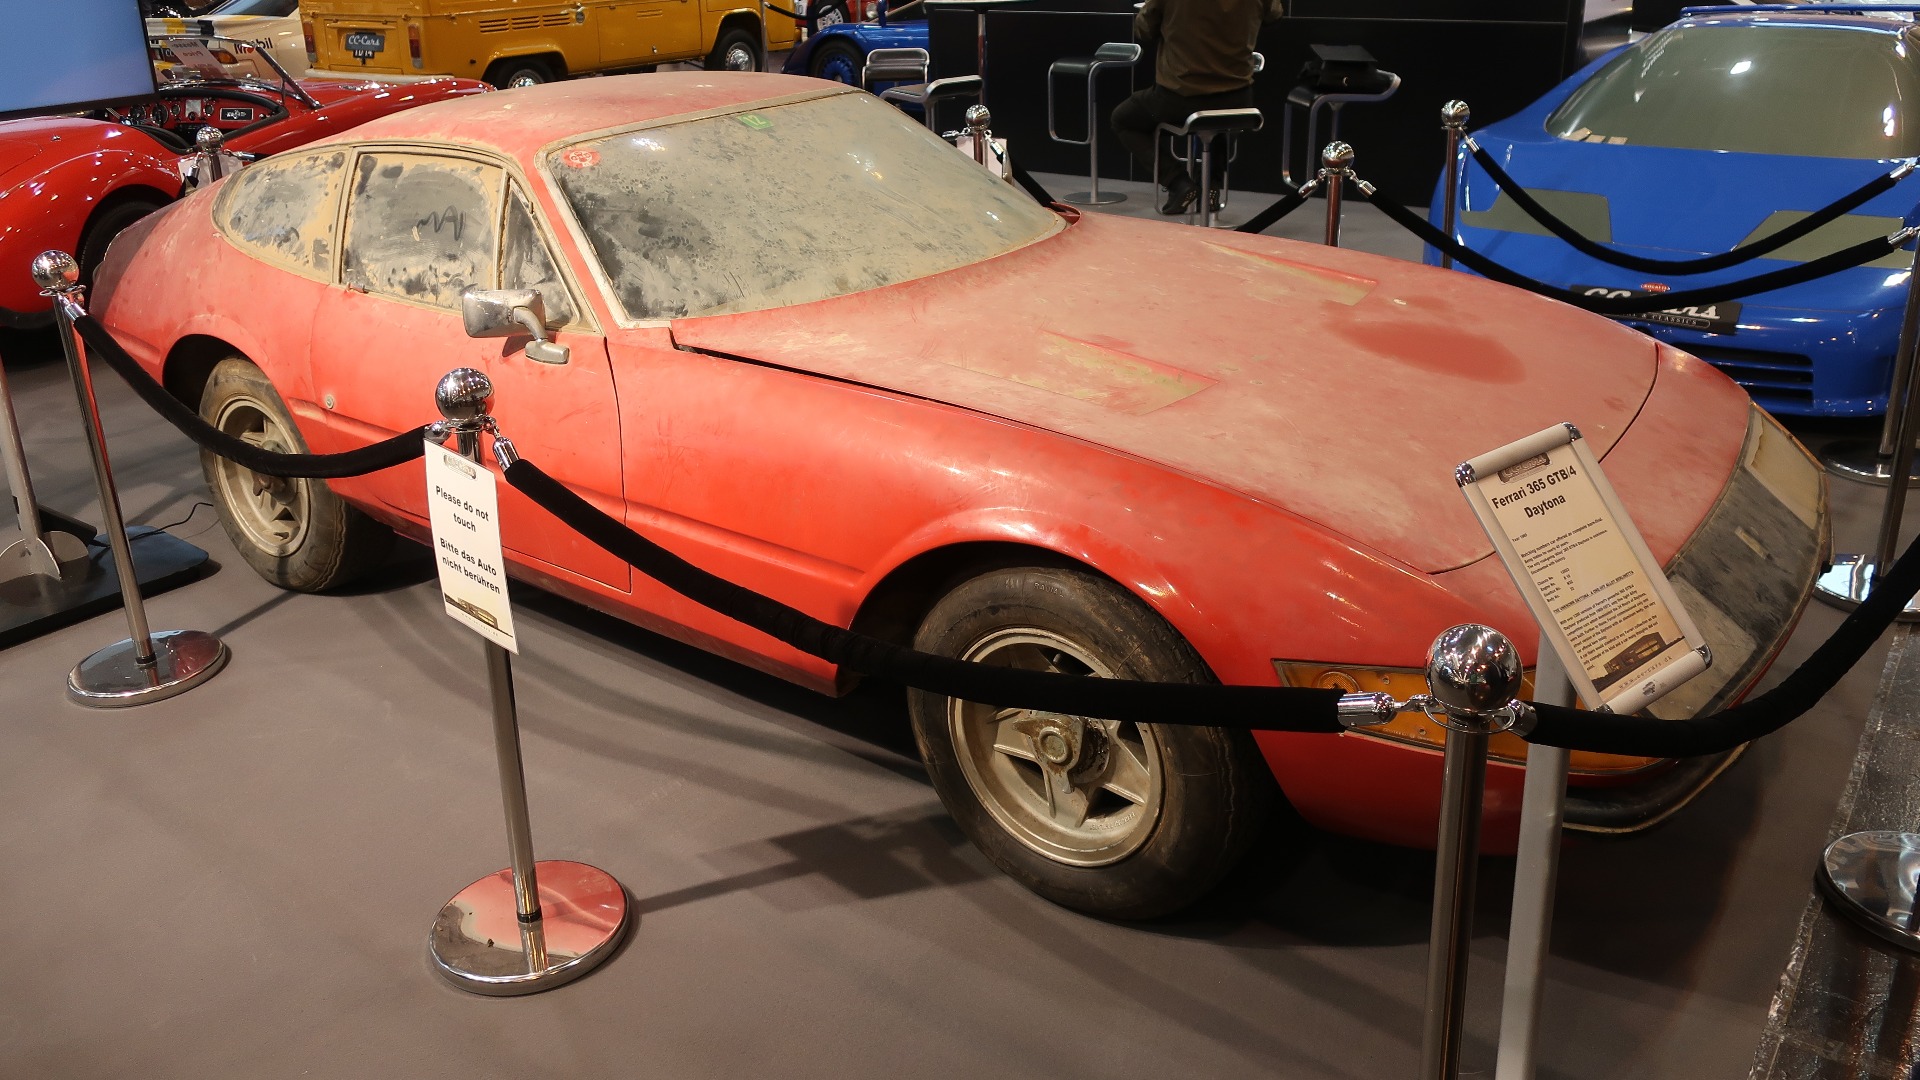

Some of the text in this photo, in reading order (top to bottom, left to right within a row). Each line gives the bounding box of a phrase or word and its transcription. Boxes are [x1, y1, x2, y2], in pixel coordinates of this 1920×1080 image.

[348, 34, 380, 46] CC-Cars
[1652, 314, 1697, 326] CLASSICS
[1491, 487, 1526, 508] Ferrari
[1526, 478, 1546, 494] 365
[1546, 465, 1576, 485] GTB/4
[436, 484, 490, 523] Please do not
[1524, 495, 1566, 518] Daytona
[453, 512, 477, 533] touch
[440, 536, 498, 577] Bitte das Auto
[442, 555, 501, 595] nicht berühren
